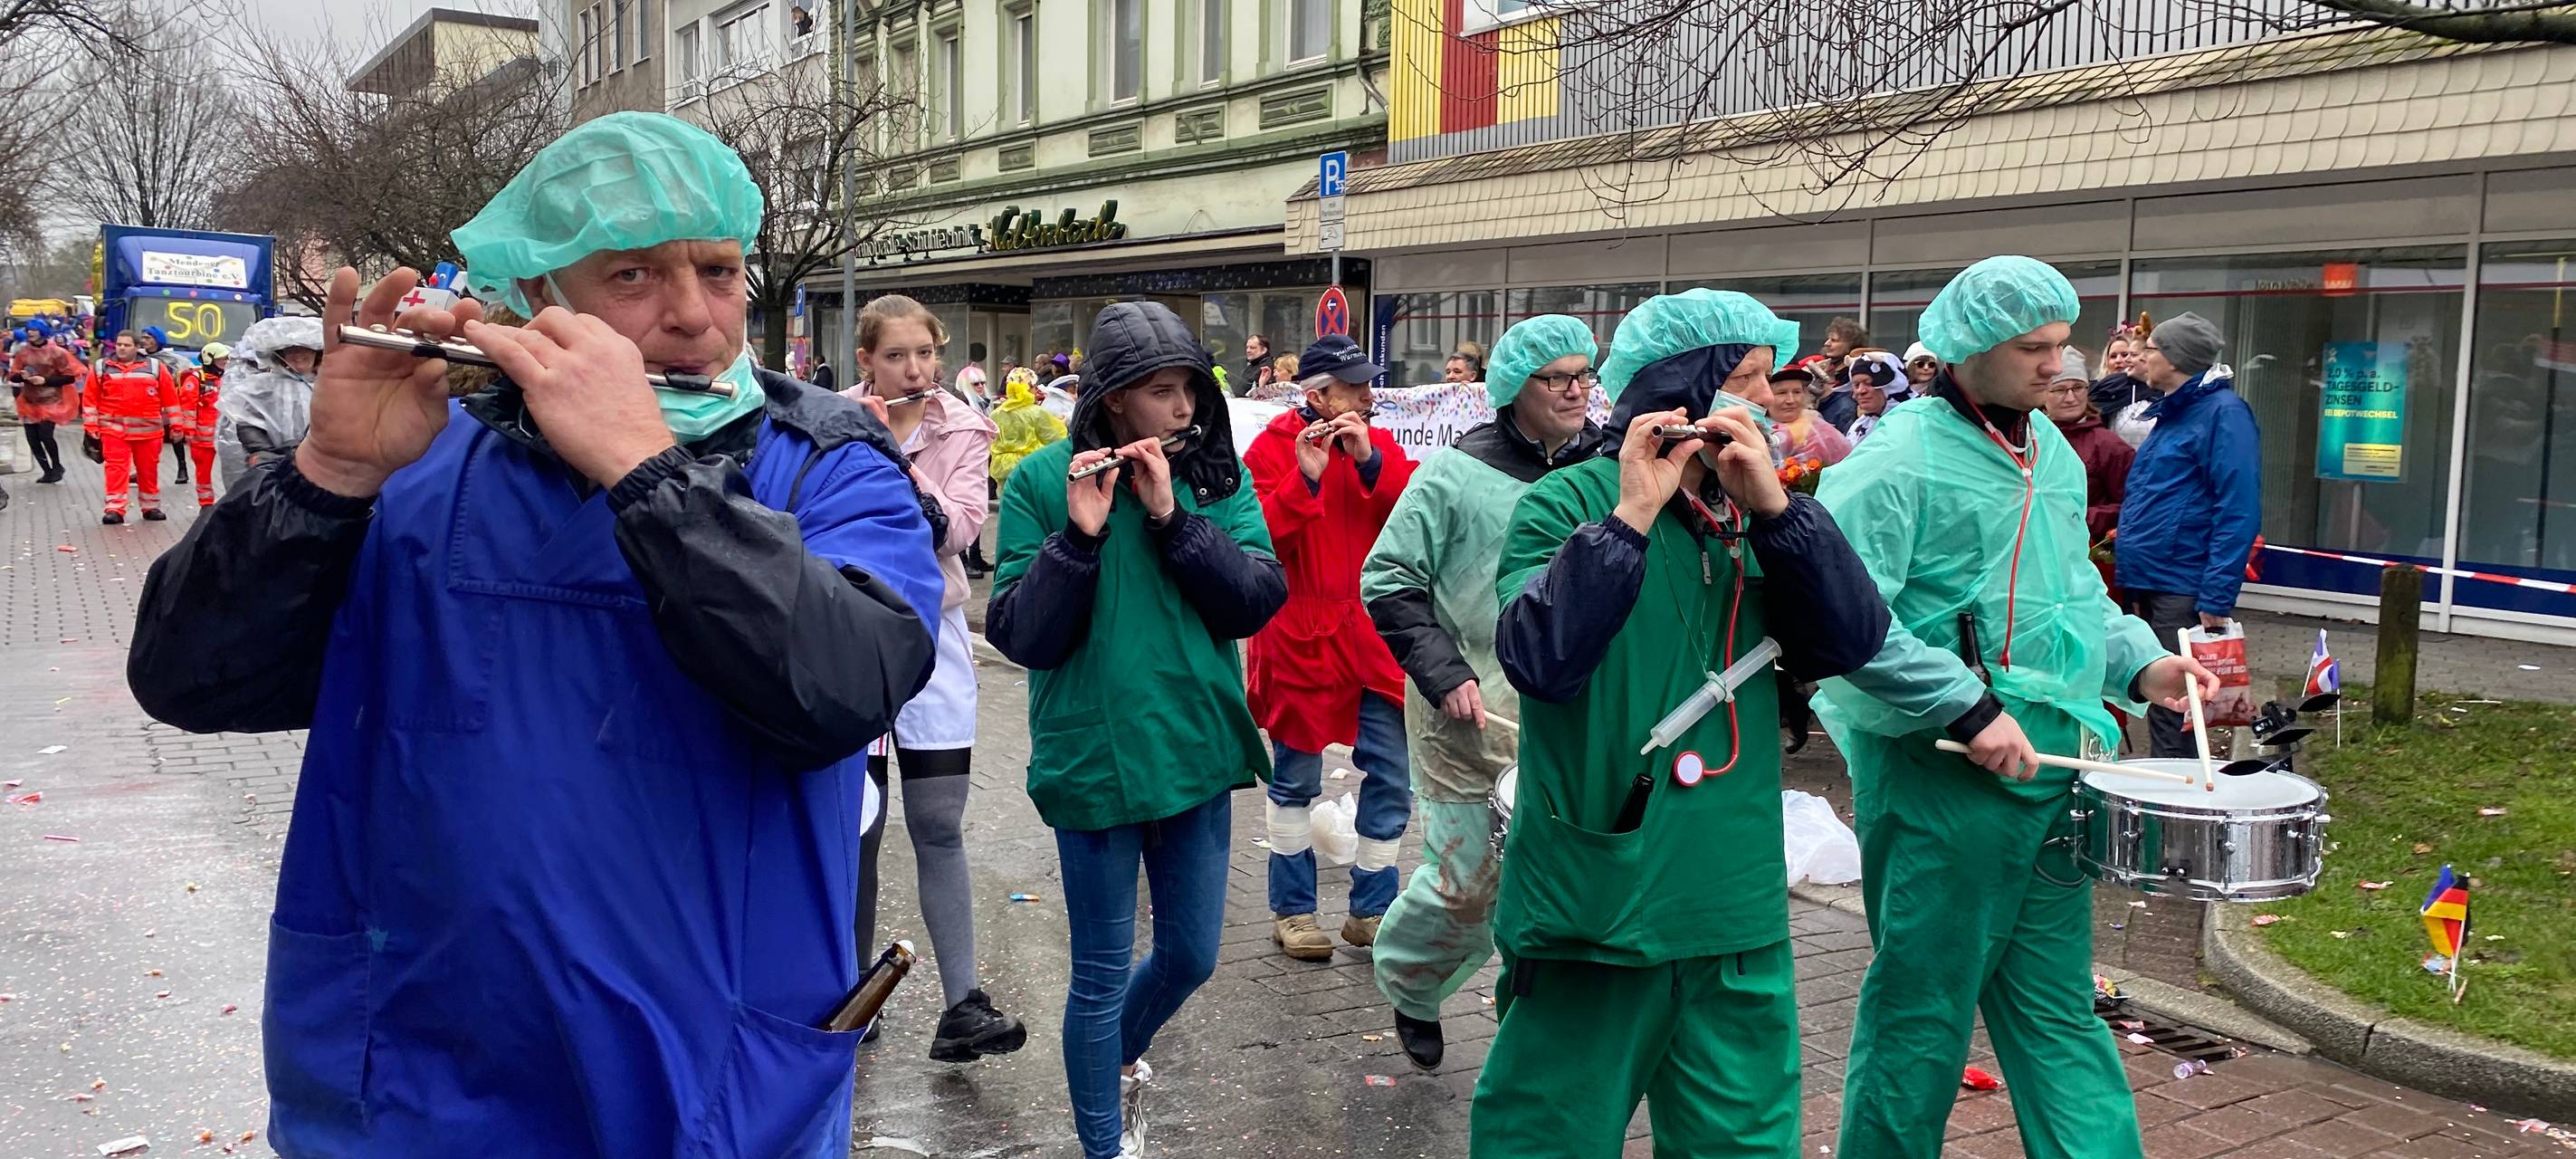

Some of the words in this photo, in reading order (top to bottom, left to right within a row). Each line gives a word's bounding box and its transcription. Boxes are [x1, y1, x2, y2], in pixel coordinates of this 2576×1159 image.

[1325, 159, 1340, 196] P
[797, 288, 803, 313] P
[167, 302, 222, 339] 50
[2326, 381, 2400, 393] TAGESGELD-
[2325, 395, 2362, 406] ZINSEN
[1436, 423, 1464, 446] Ma
